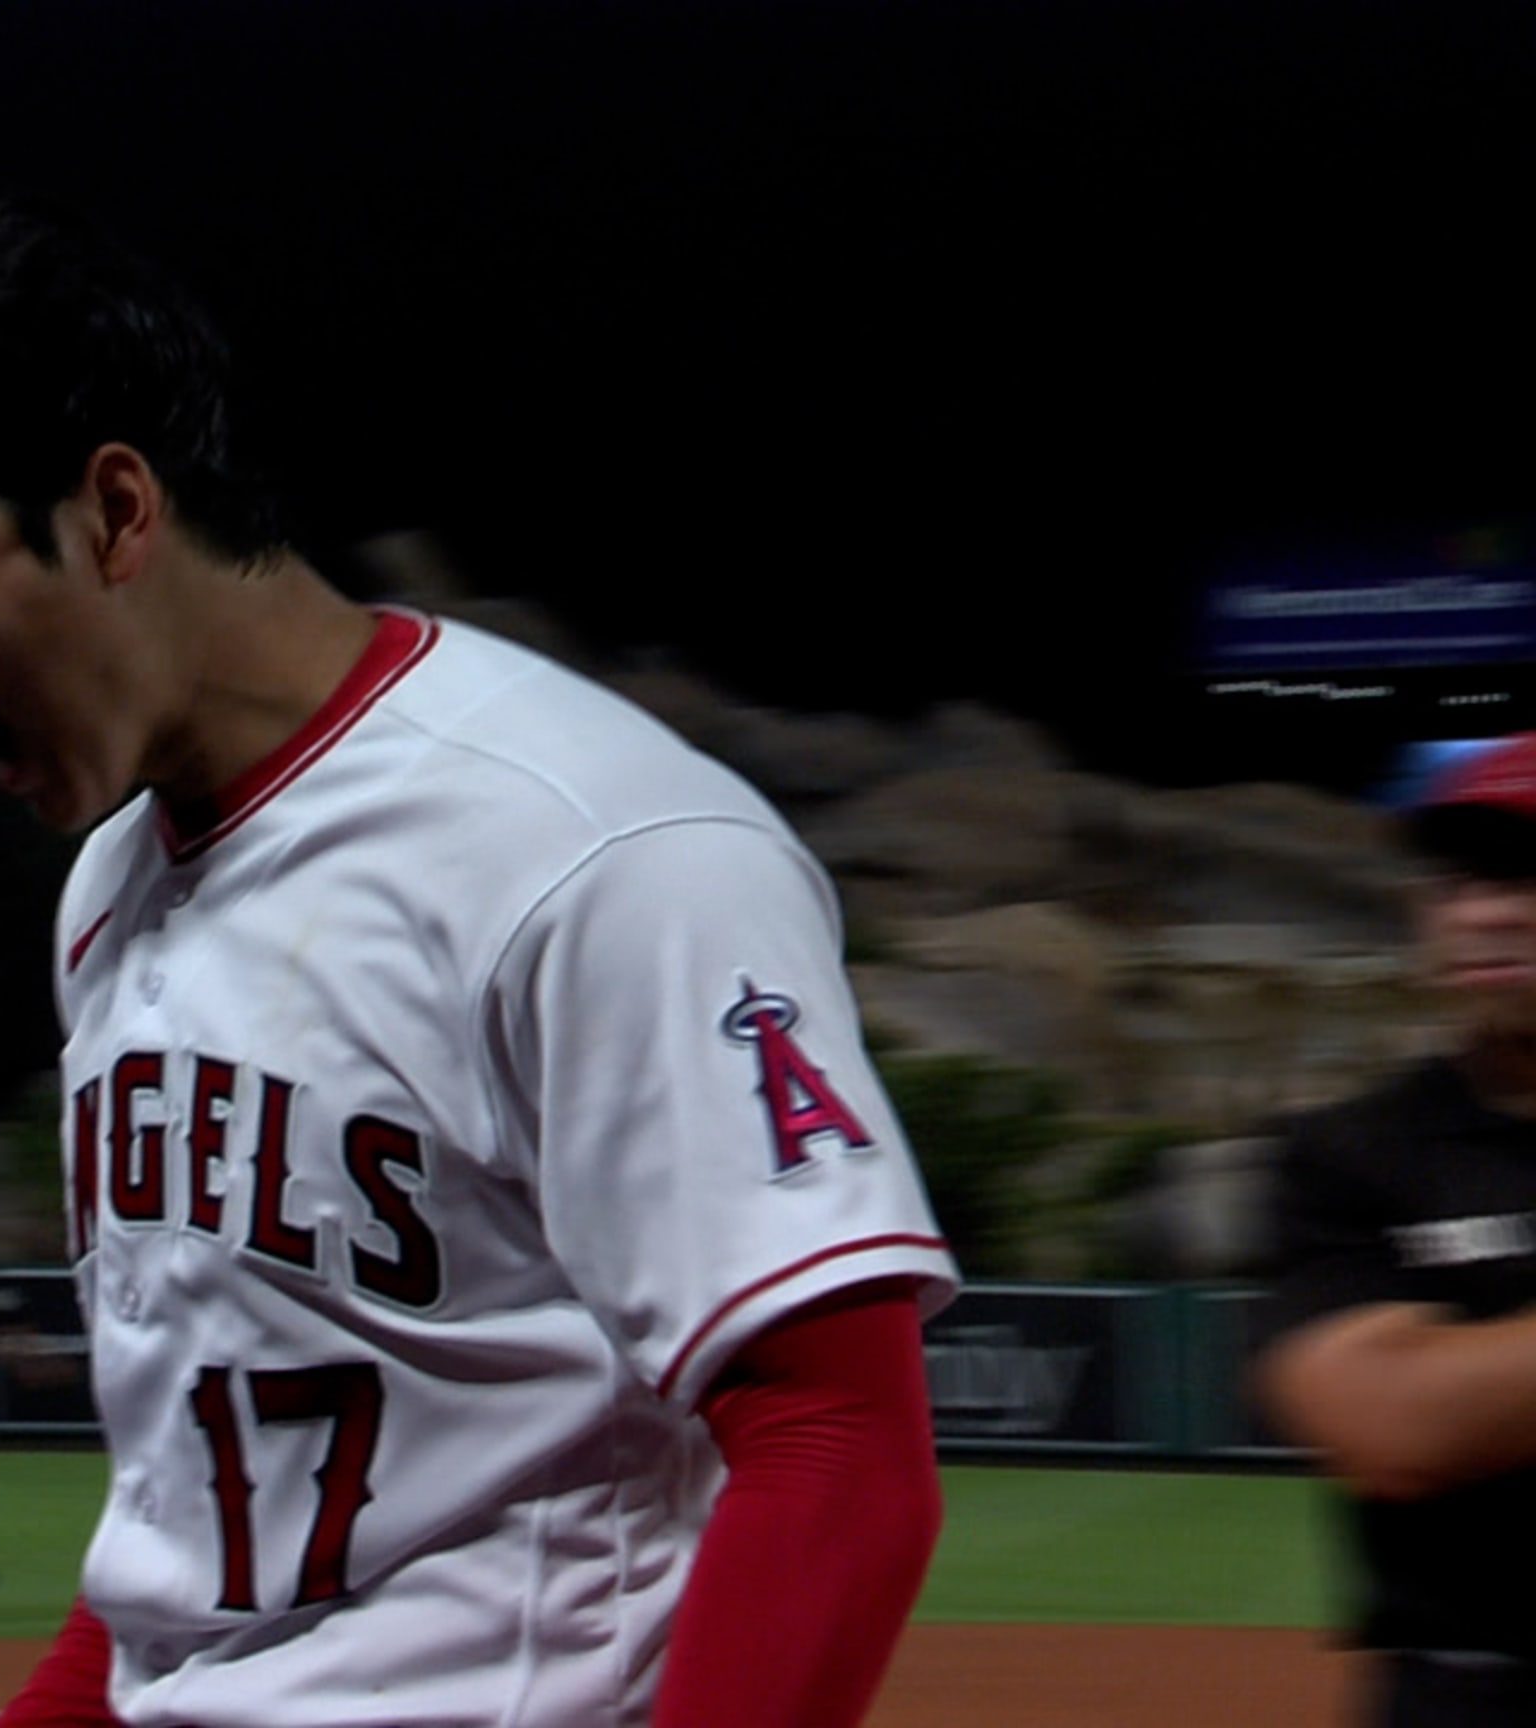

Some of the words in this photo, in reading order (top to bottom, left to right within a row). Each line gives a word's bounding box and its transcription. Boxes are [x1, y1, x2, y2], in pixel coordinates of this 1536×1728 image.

[72, 1052, 439, 1305] NGELS
[723, 974, 874, 1172] A
[190, 1361, 383, 1611] 17
